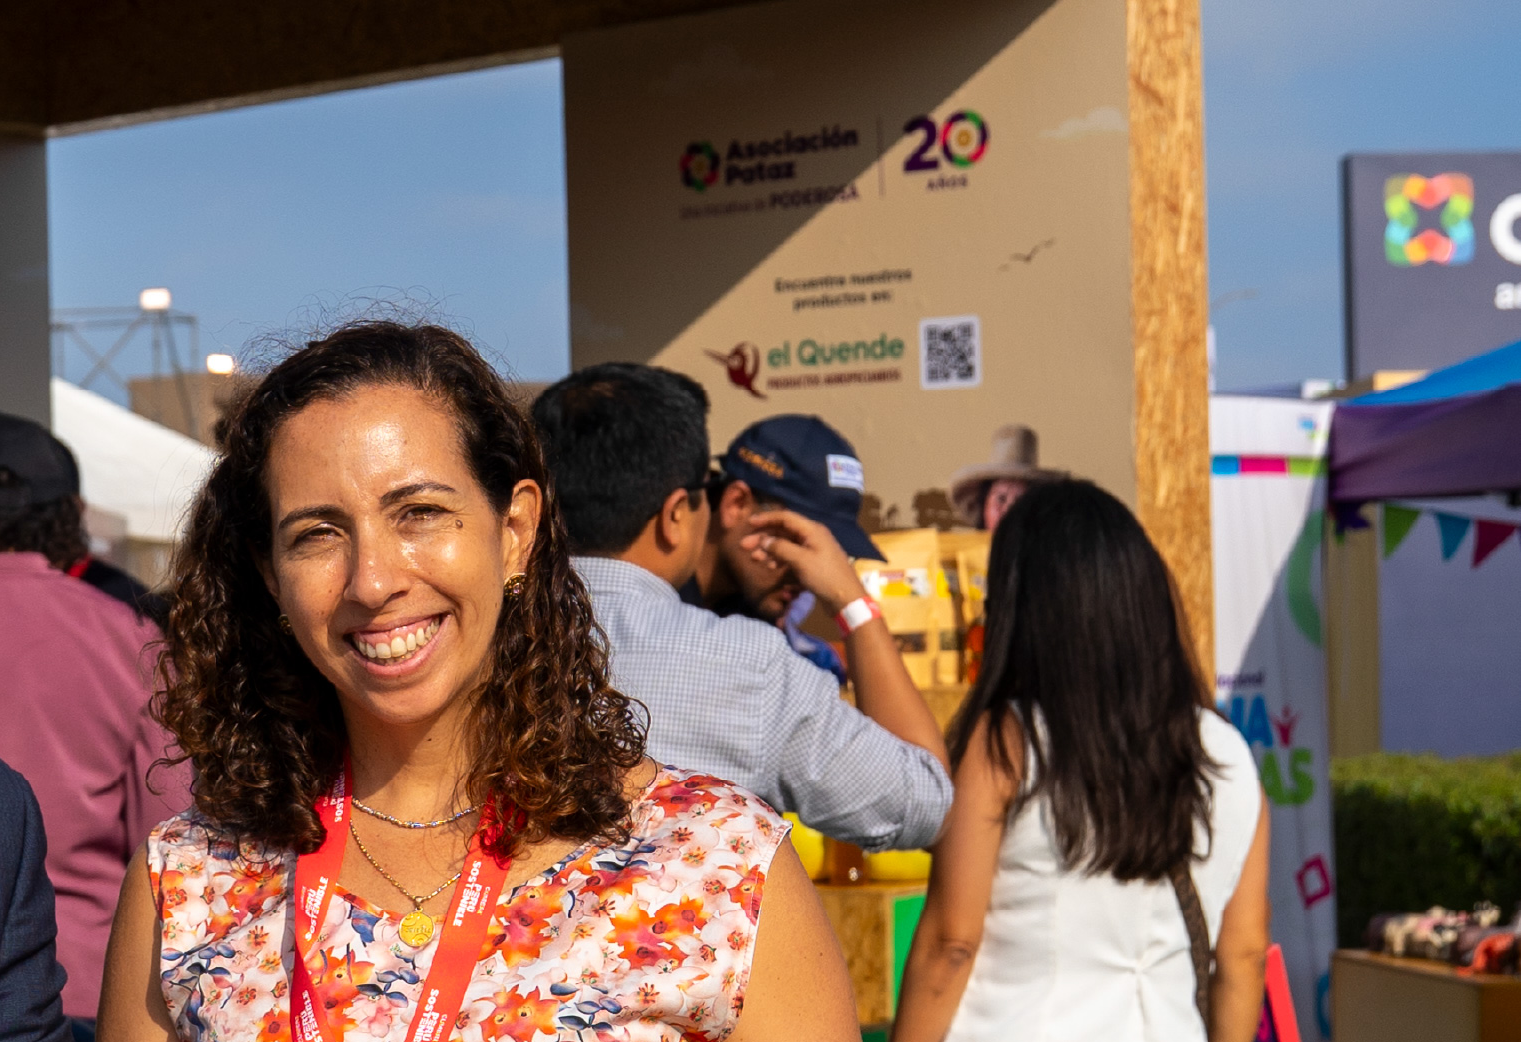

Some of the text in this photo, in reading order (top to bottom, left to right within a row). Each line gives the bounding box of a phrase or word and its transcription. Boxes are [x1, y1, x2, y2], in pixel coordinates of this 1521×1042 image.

[767, 332, 905, 368] el Quende
[453, 861, 482, 927] SOSTENIBLE
